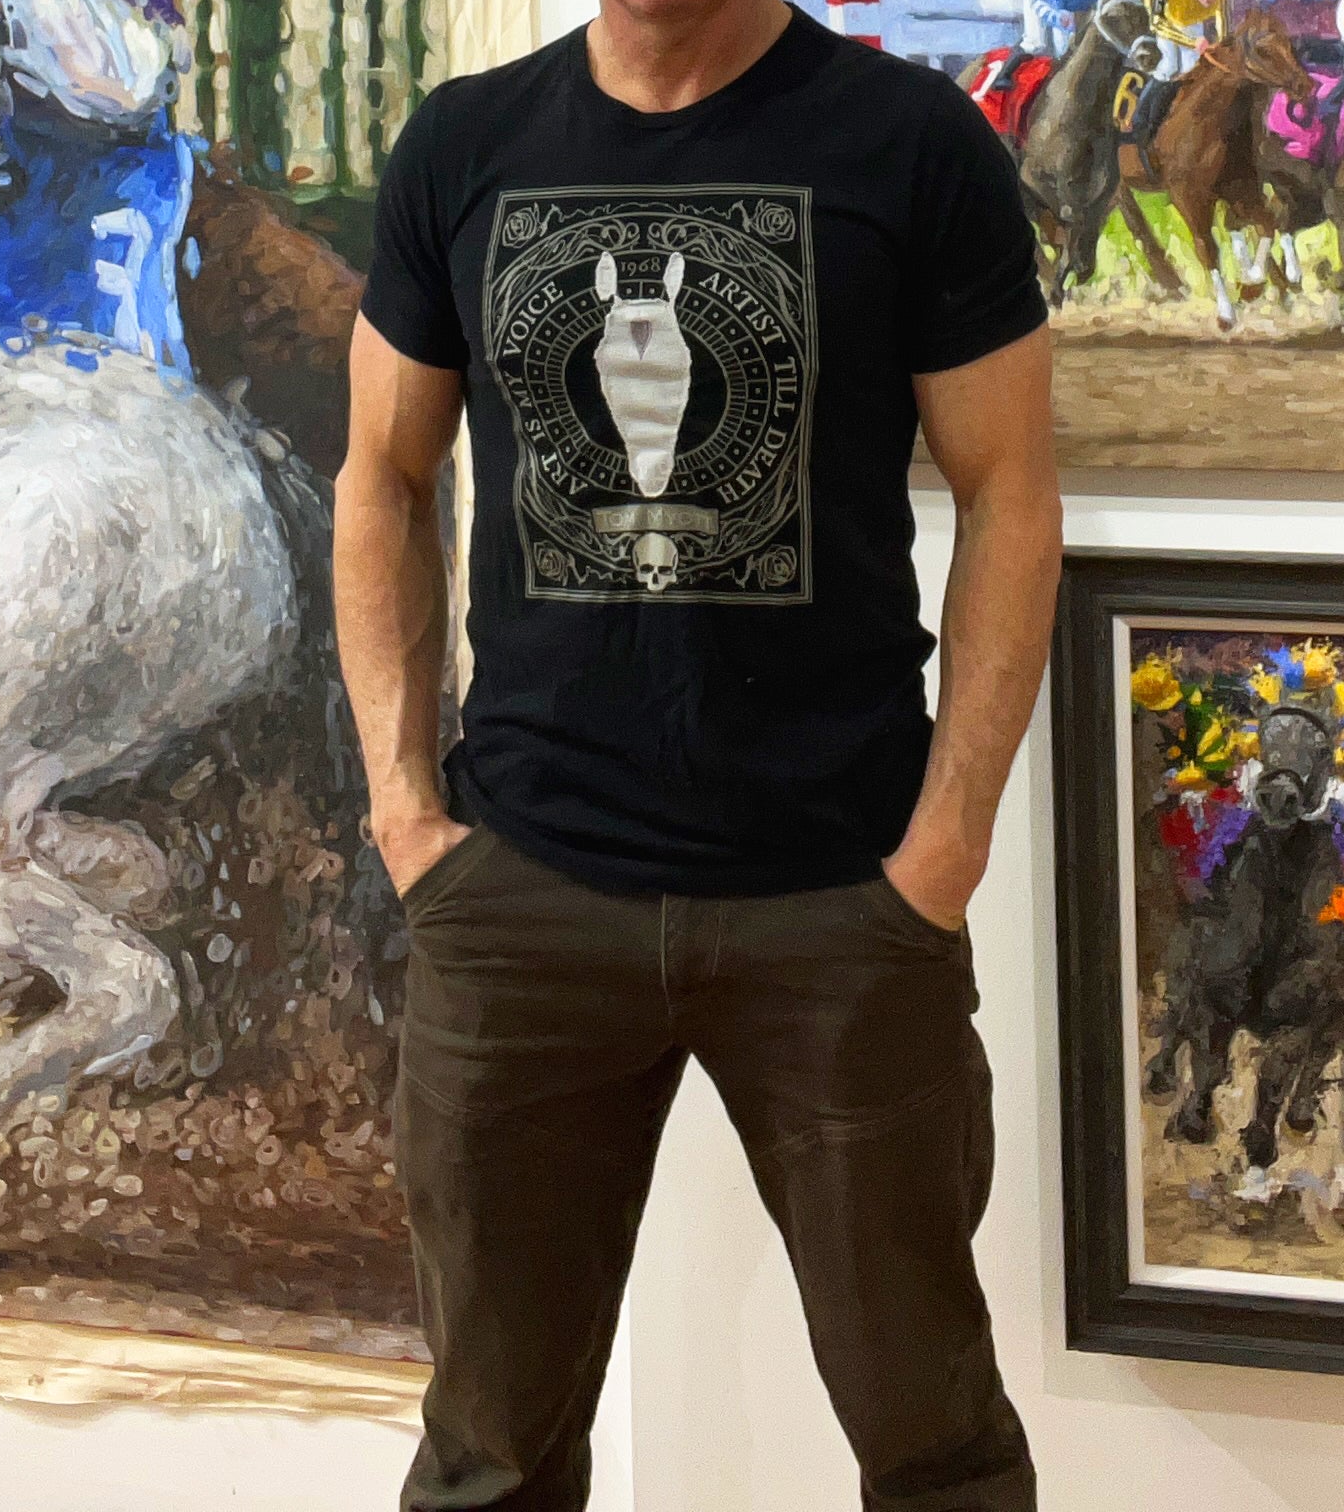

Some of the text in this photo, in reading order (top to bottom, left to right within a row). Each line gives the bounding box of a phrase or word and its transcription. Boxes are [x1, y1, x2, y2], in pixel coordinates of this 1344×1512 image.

[971, 60, 1004, 102] 1
[621, 256, 661, 277] 1968
[503, 281, 589, 496] ART IS MY VOICE
[699, 272, 798, 505] ARTIST TILL DEATH
